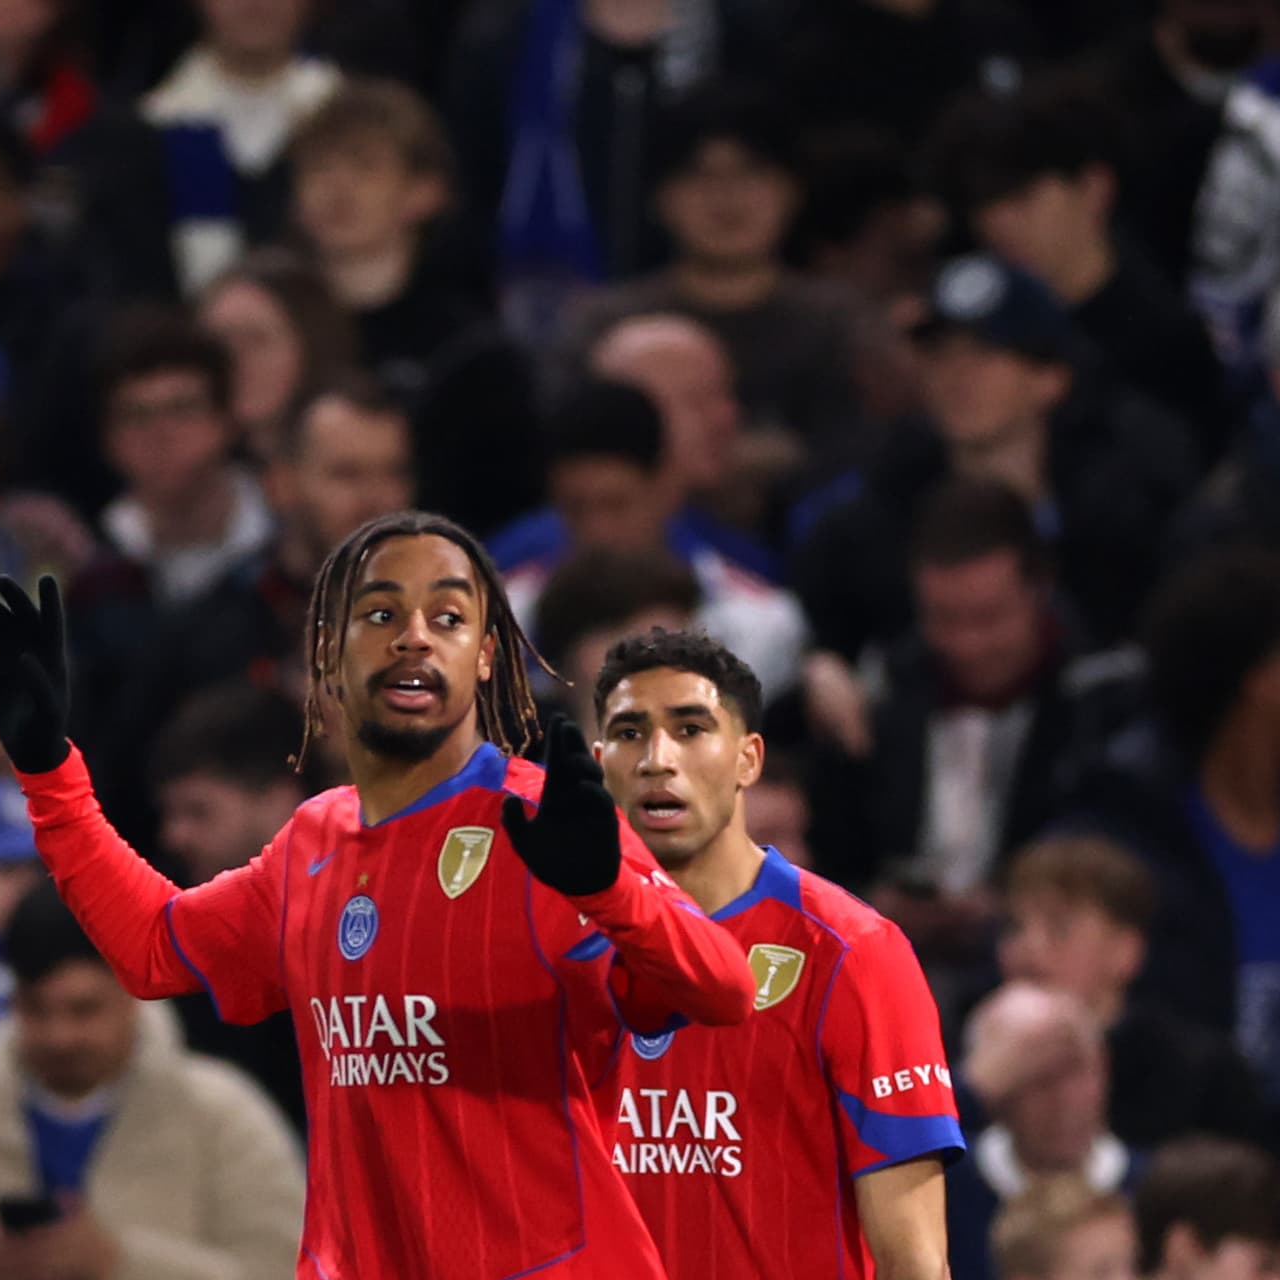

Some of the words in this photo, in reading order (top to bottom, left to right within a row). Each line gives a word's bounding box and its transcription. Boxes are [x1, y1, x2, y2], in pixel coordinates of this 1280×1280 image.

[310, 993, 445, 1061] QATAR
[330, 1051, 449, 1086] AIRWAYS
[617, 1087, 742, 1140] ATAR
[611, 1143, 742, 1177] AIRWAYS
